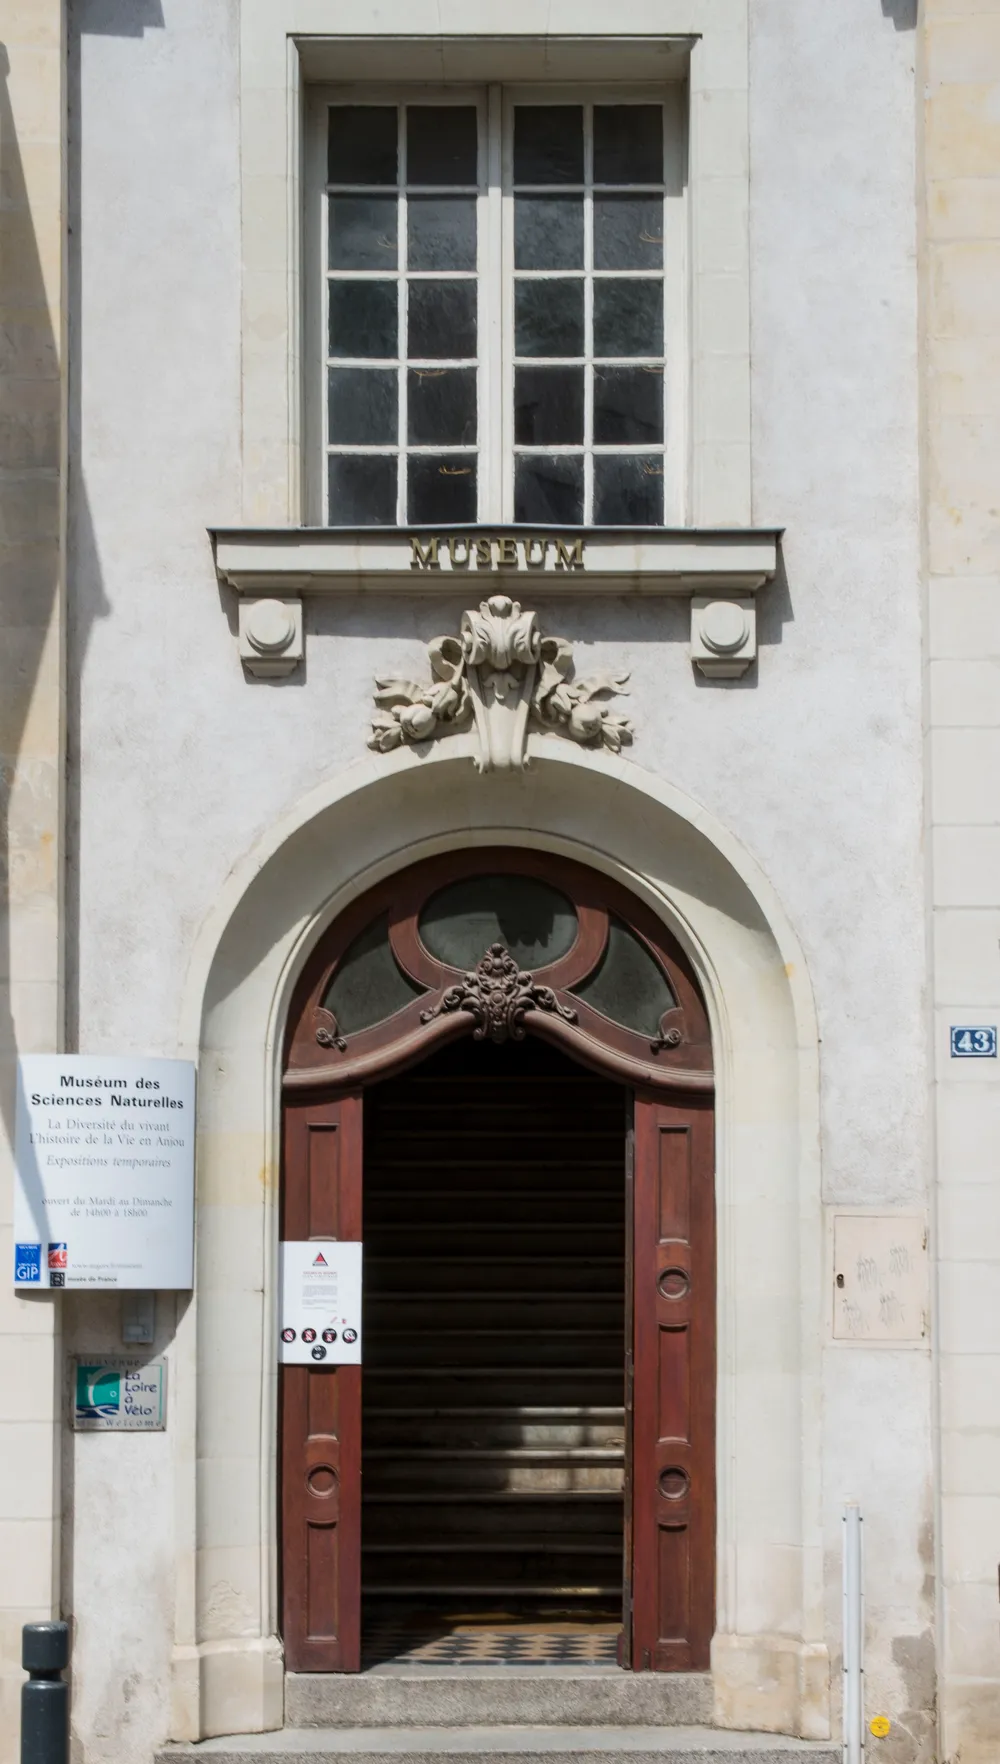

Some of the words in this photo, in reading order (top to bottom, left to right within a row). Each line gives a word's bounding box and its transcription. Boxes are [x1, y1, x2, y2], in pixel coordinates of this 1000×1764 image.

[409, 536, 585, 565] MUSEUM
[957, 1030, 990, 1052] 43
[60, 1075, 127, 1089] Muséum
[135, 1077, 160, 1090] des
[31, 1094, 102, 1107] Sciences
[110, 1095, 184, 1109] Naturelles
[47, 1118, 61, 1129] La
[66, 1118, 116, 1130] Diversité
[120, 1119, 135, 1131] du
[139, 1120, 170, 1132] vivant
[29, 1133, 80, 1145] L'histoire
[85, 1133, 99, 1145] de
[103, 1133, 113, 1145] la
[117, 1134, 135, 1146] Vie
[139, 1137, 152, 1146] en
[156, 1136, 185, 1149] Anjou
[46, 1155, 108, 1168] Expositions
[112, 1156, 171, 1170] temporaires
[41, 1198, 70, 1206] ouvert
[73, 1196, 86, 1206] du
[89, 1196, 116, 1206] Mardi
[132, 1197, 173, 1207] Dimanche
[70, 1209, 80, 1217] de
[16, 1266, 39, 1280] GIP
[124, 1369, 141, 1381] La
[124, 1382, 157, 1393] Loire
[124, 1393, 133, 1404] à
[124, 1404, 153, 1416] Vélo
